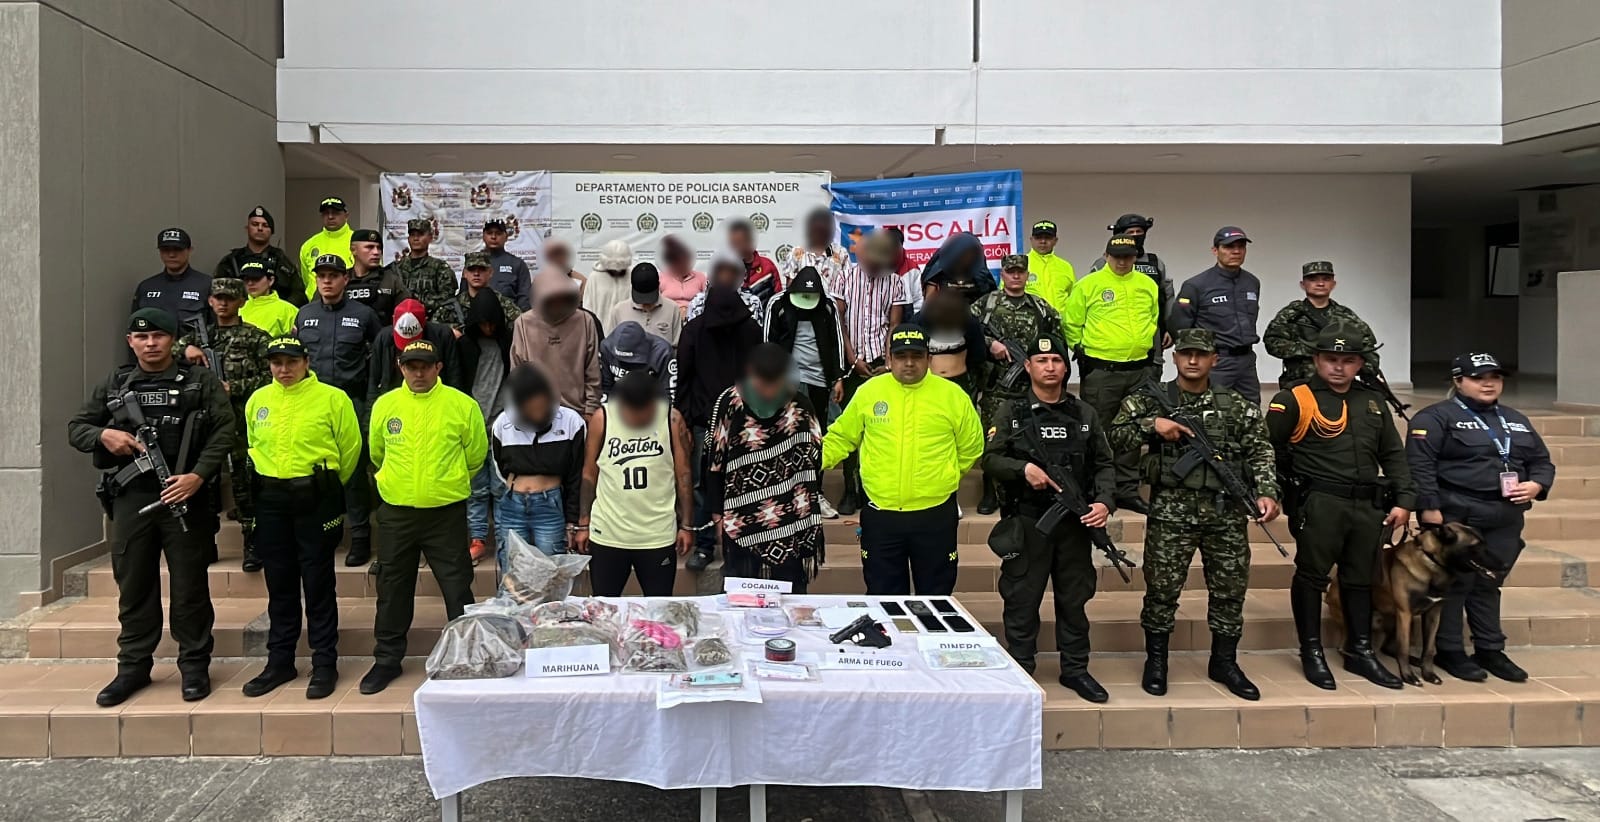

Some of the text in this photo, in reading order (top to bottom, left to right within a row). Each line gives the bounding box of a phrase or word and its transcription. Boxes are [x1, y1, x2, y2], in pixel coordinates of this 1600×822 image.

[575, 182, 800, 192] DEPARTAMENTO DE POLICIA SANTANDER
[599, 195, 776, 204] ESTACION DE POLICIA BARBOSA
[163, 230, 180, 238] CTI
[984, 245, 1008, 257] CIÓN
[318, 254, 337, 263] CTI
[1211, 295, 1228, 303] CTI
[141, 394, 162, 404] OES
[1456, 421, 1480, 429] CTI
[608, 436, 662, 458] Boston
[623, 466, 648, 490] 10
[741, 582, 780, 590] COCAINA
[838, 657, 861, 665] ARMA
[876, 659, 903, 667] FUEGO
[542, 663, 600, 673] MARIHUANA
